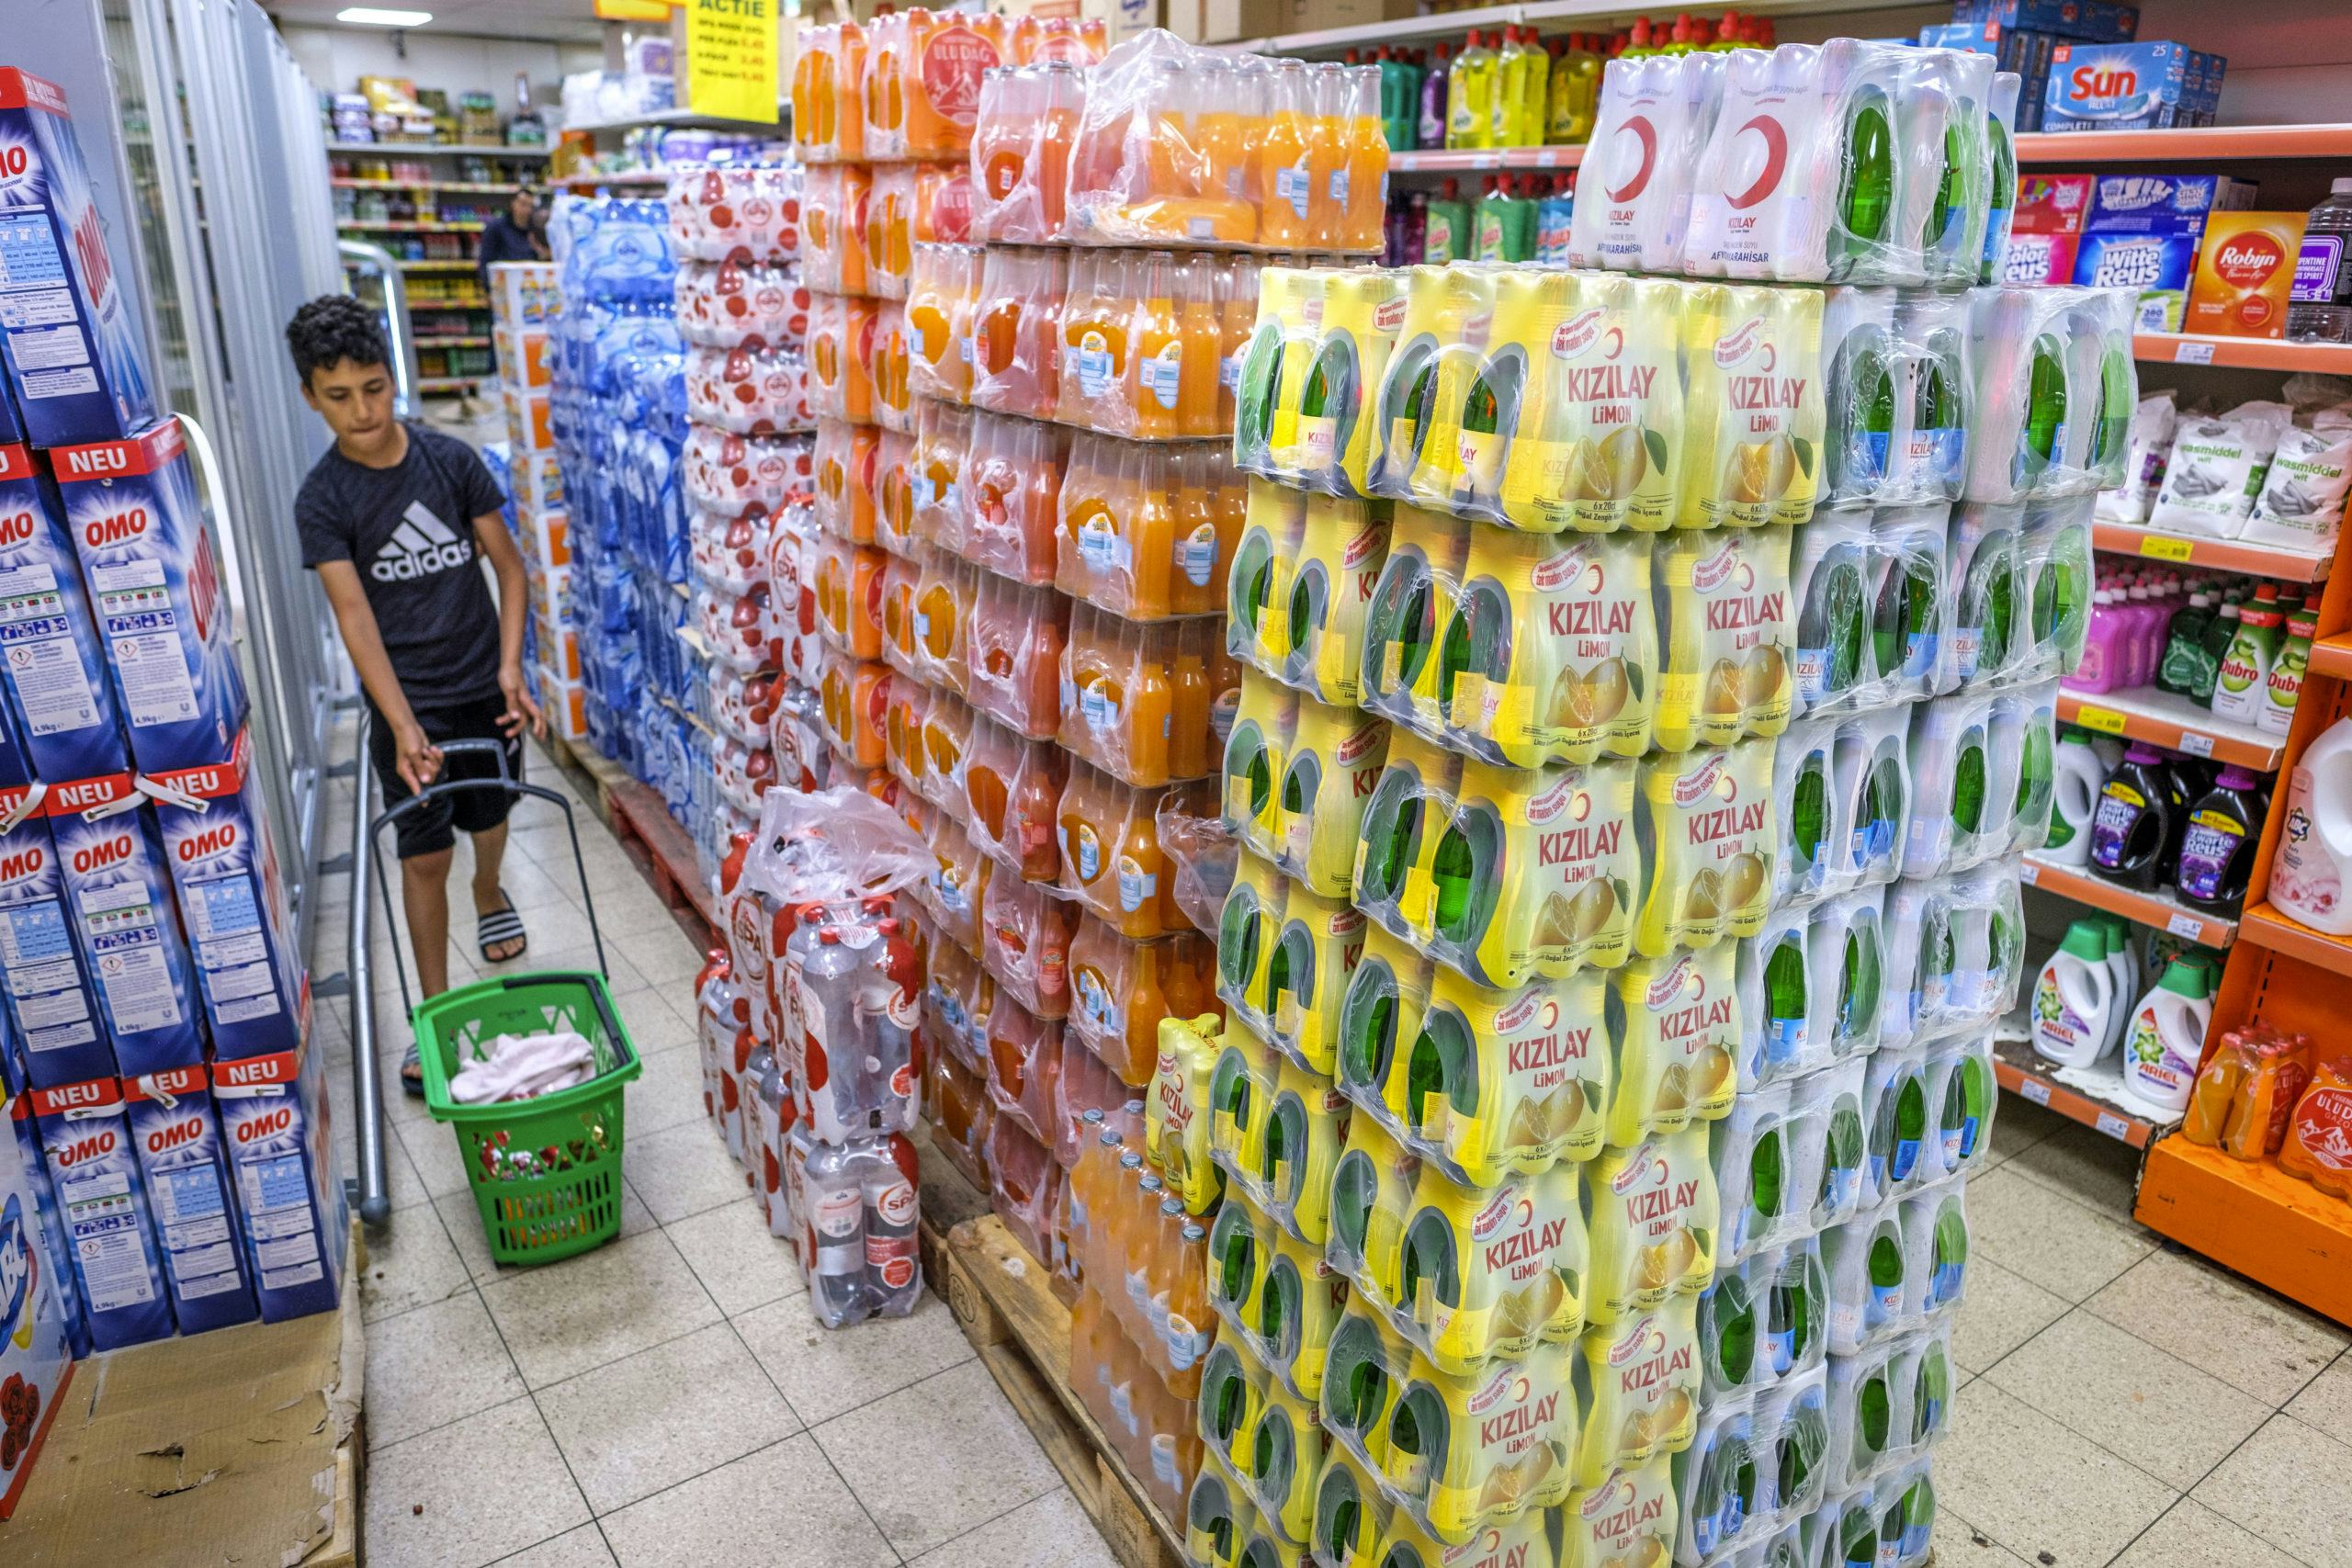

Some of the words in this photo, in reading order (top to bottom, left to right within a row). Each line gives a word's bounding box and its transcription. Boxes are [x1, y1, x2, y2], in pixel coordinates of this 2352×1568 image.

[2153, 44, 2167, 57] 25
[2069, 66, 2137, 102] Sun
[2005, 262, 2050, 281] eus
[2105, 248, 2157, 266] Witte
[2220, 245, 2277, 269] Robijn
[2094, 265, 2160, 288] Reus
[1567, 365, 1658, 402] KIZILAY
[1727, 376, 1807, 412] KIZILAY
[68, 447, 128, 474] NEU
[2180, 444, 2243, 459] wasmiddel
[2276, 457, 2343, 479] wasmiddel
[2293, 473, 2309, 482] wit
[85, 508, 147, 547] OMO
[370, 539, 472, 582] adidas
[1548, 600, 1636, 637] KIZILAY
[1706, 590, 1785, 632] KIZILAY
[2220, 658, 2258, 682] Dubro
[57, 781, 115, 808] NEU
[164, 770, 220, 796] NEU
[1688, 798, 1767, 846] KIZILAY
[2098, 808, 2130, 829] Reus
[74, 835, 132, 874] OMO
[178, 823, 236, 863] OMO
[1539, 818, 1623, 868] KIZILAY
[2186, 839, 2227, 857] Reus
[2189, 829, 2233, 849] Zwarte
[1659, 996, 1733, 1043] KIZILAY
[2041, 1020, 2077, 1043] ARIEL
[1508, 1026, 1592, 1076] KIZILAY
[229, 1060, 279, 1085] NEU
[2138, 1063, 2180, 1086] ARIEL
[47, 1084, 100, 1108] NEU
[1159, 1081, 1193, 1129] KIZILAY
[147, 1117, 203, 1153] OMO
[236, 1108, 291, 1143] OMO
[58, 1131, 116, 1168] OMO
[1625, 1179, 1700, 1228] KIZILAY
[1485, 1216, 1566, 1275] KIZILAY
[1621, 1342, 1692, 1394] KIZILAY
[1481, 1390, 1560, 1450] KIZILAY
[1592, 1493, 1664, 1544] KIZILAY
